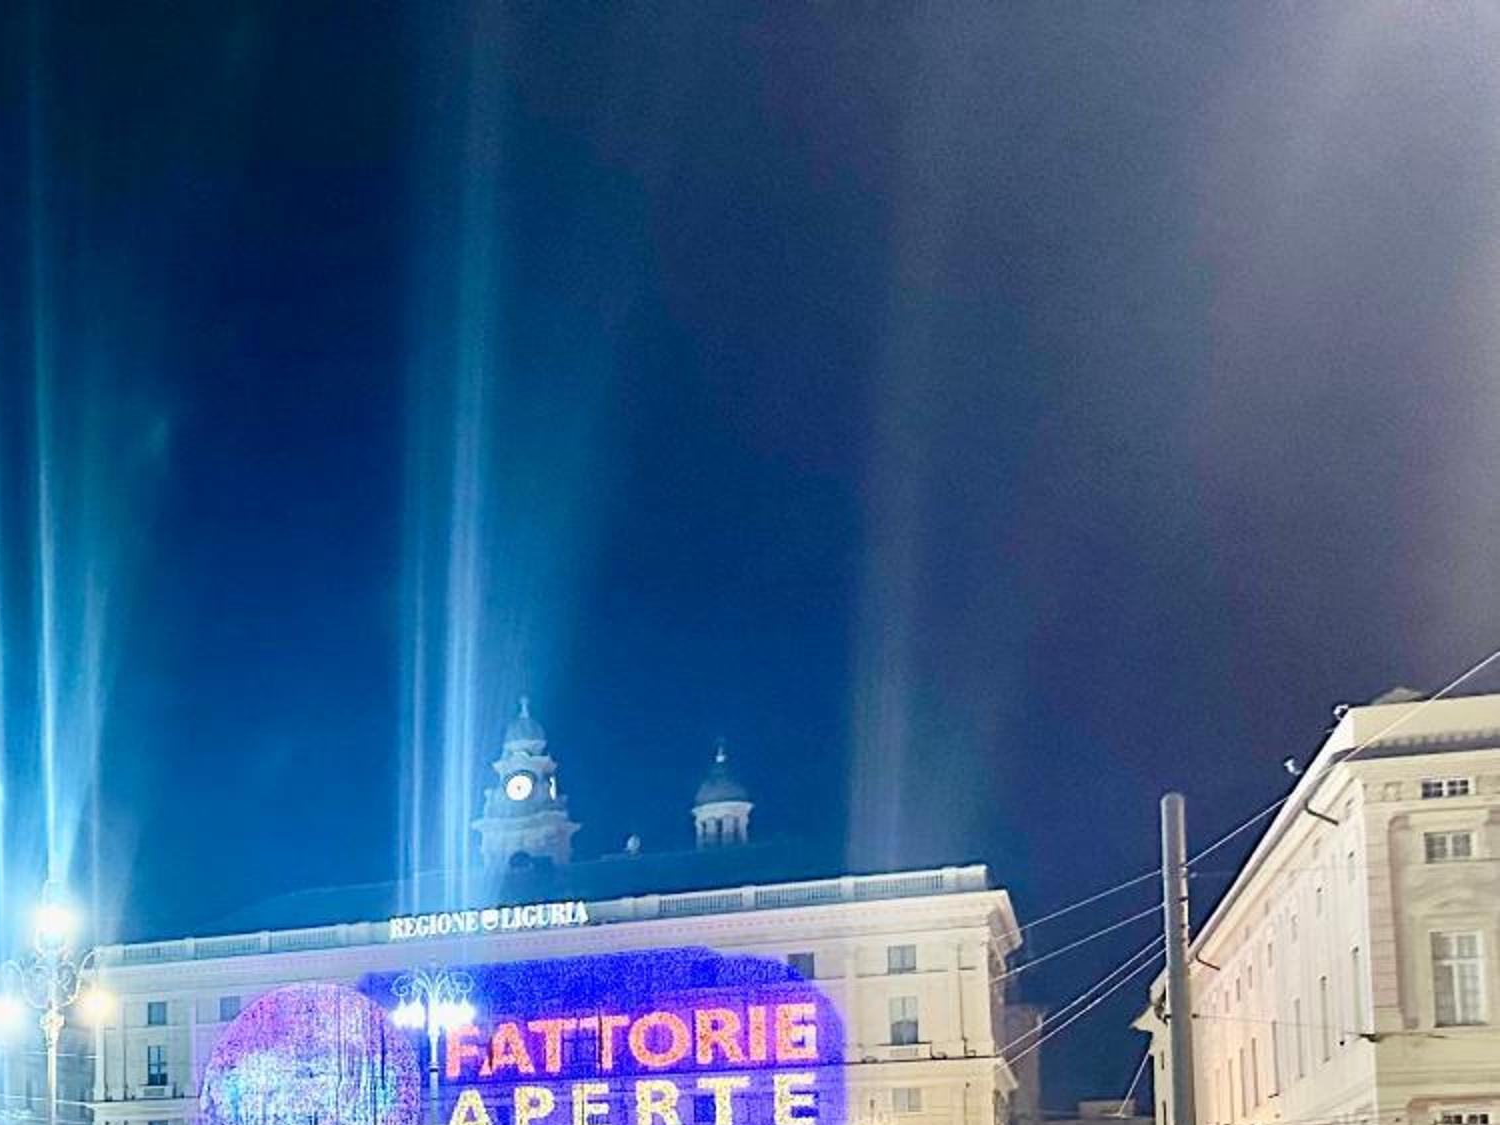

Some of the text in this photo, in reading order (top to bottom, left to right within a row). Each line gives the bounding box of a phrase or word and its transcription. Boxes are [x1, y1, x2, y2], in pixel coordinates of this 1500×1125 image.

[389, 900, 589, 939] REGIONE LIGURIA
[445, 1002, 818, 1078] FATTORIE
